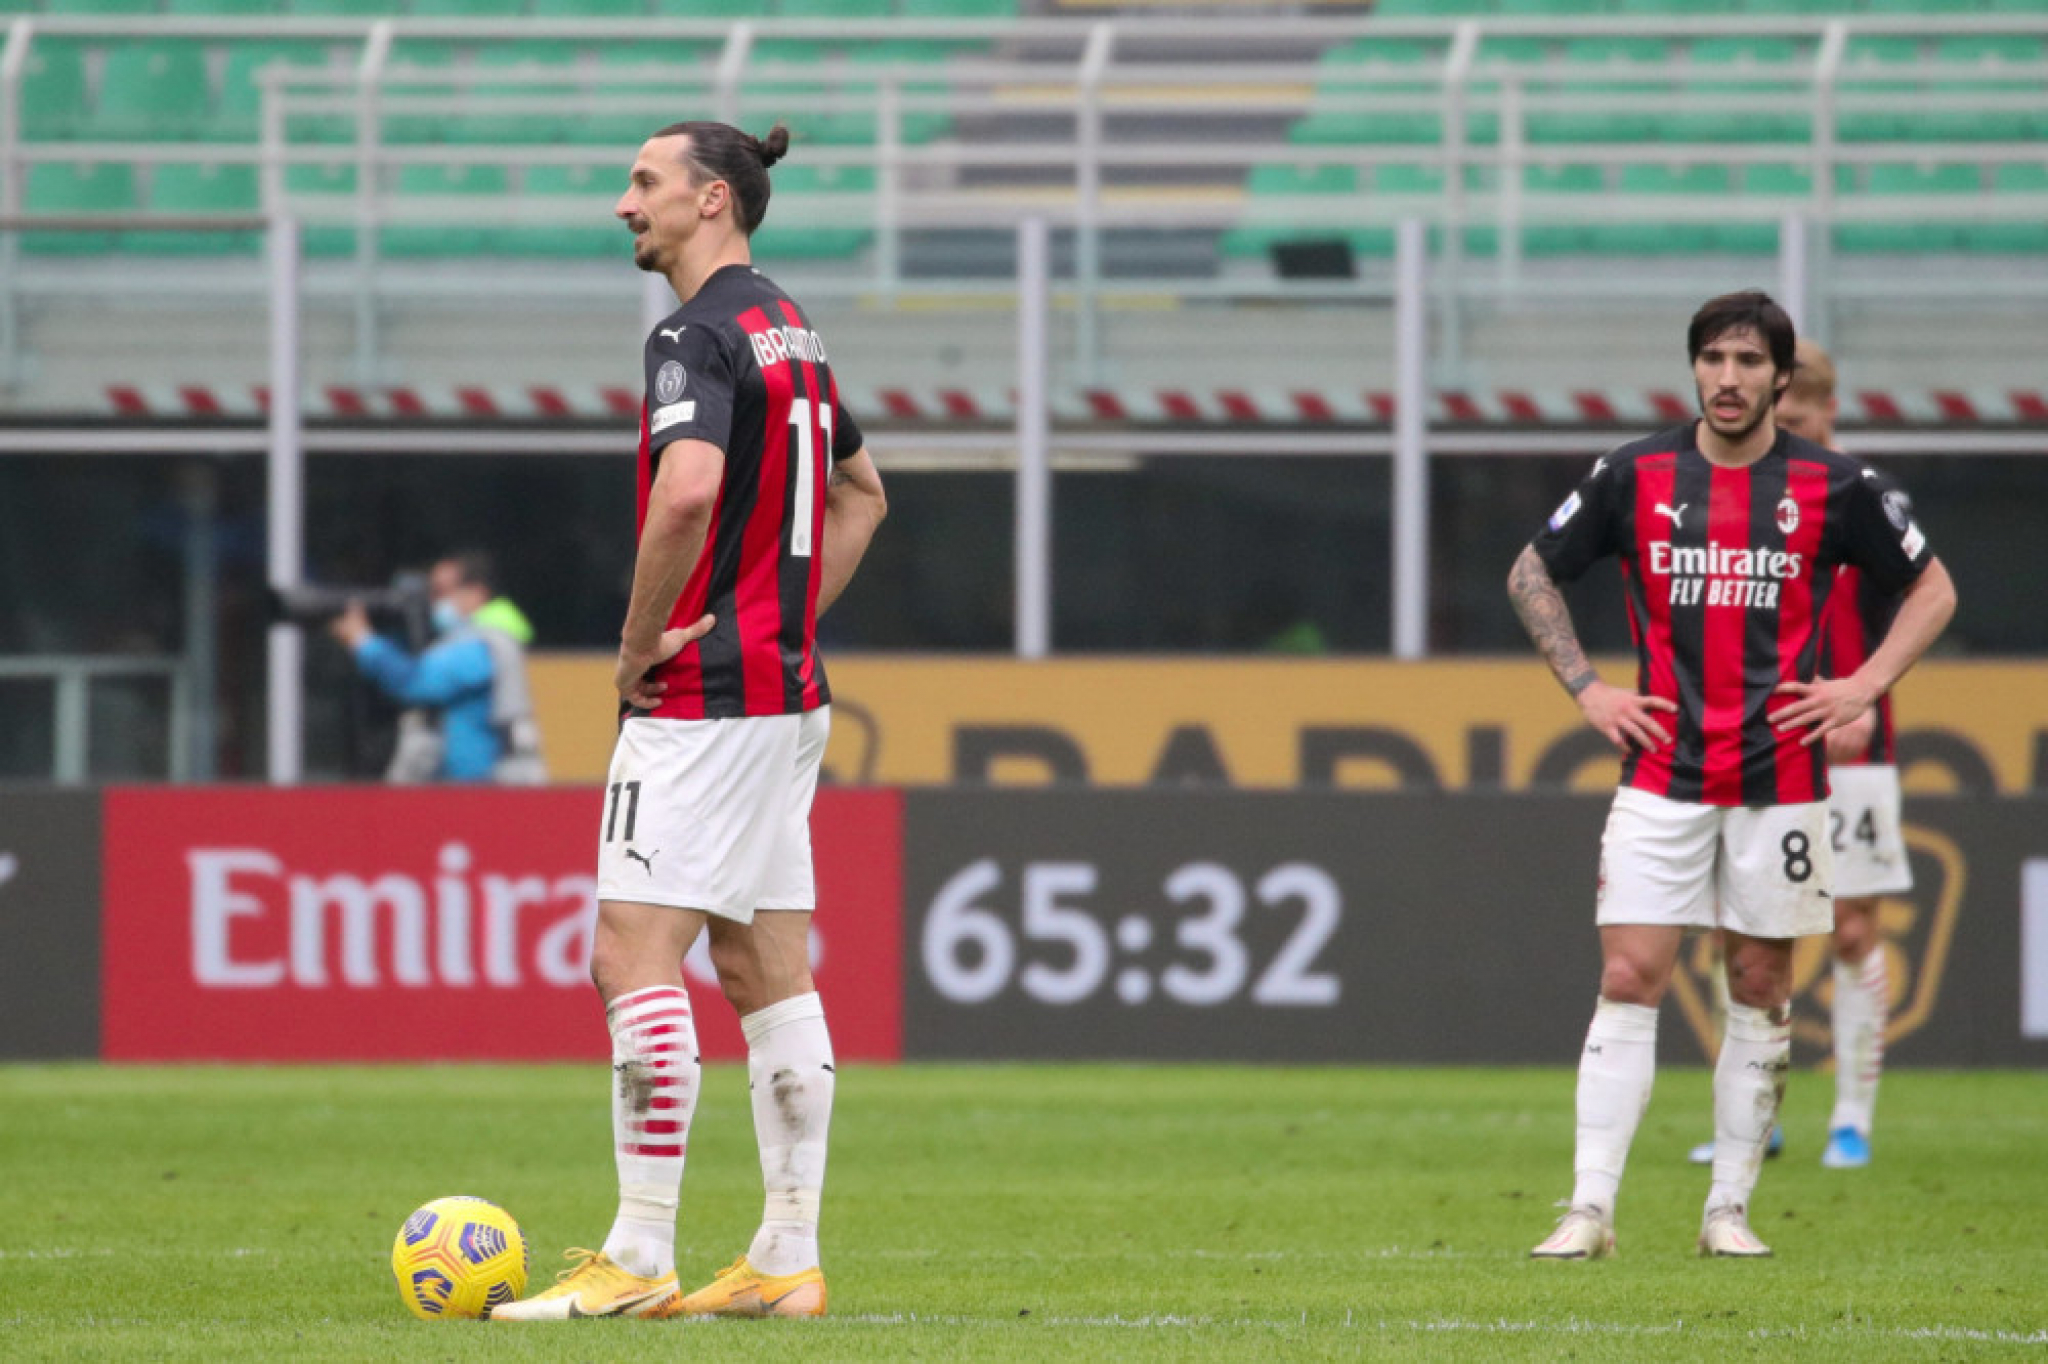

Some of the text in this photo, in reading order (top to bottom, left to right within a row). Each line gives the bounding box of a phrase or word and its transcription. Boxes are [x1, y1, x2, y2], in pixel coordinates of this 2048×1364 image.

[788, 398, 833, 557] 11
[1649, 540, 1802, 579] Emirates
[1669, 577, 1780, 608] FLY BETTER
[606, 781, 641, 843] 11
[1828, 807, 1877, 852] 24
[1781, 829, 1812, 883] 8
[186, 842, 822, 987] Emira
[921, 860, 1343, 1005] 65:32
